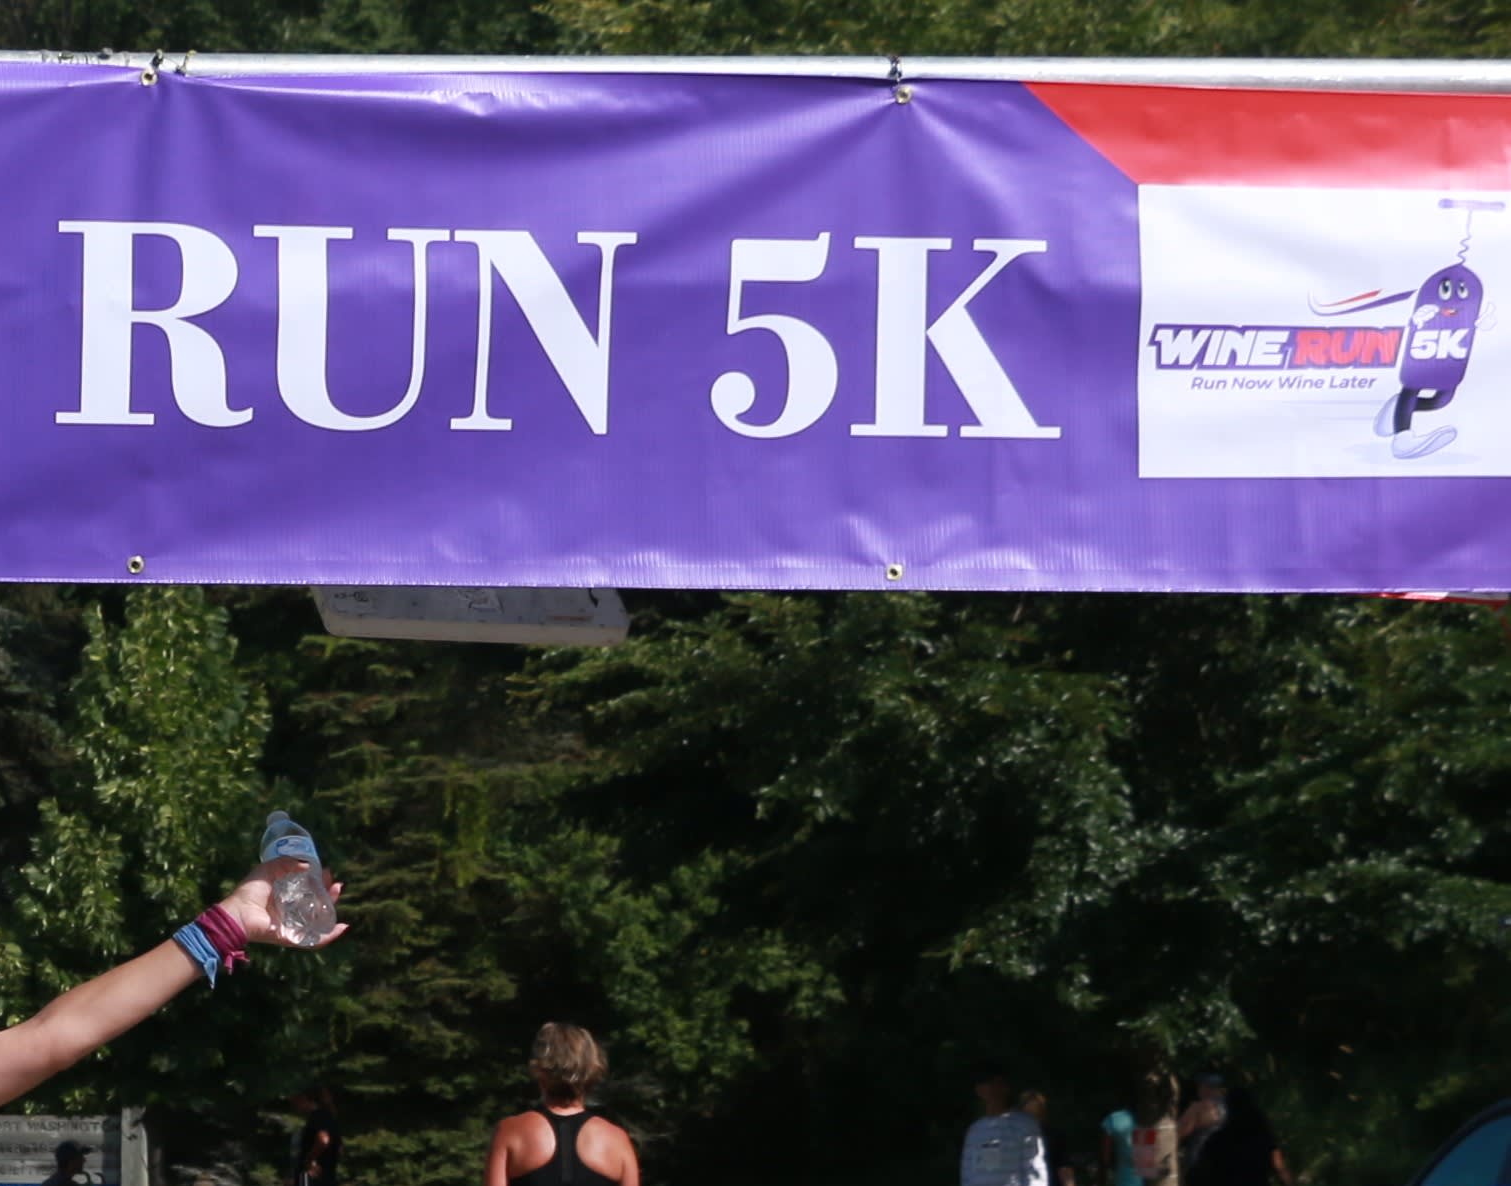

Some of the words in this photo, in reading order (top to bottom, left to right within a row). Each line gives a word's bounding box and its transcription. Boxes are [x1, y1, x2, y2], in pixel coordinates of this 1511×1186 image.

[55, 220, 638, 435] RUN
[710, 231, 1062, 440] 5K
[1154, 328, 1289, 366] WINE
[1293, 330, 1401, 366] RUN
[1409, 329, 1468, 360] 5K
[1191, 376, 1227, 390] Run
[1232, 377, 1275, 390] Now
[1278, 376, 1325, 390] Wine
[1329, 375, 1377, 390] Later
